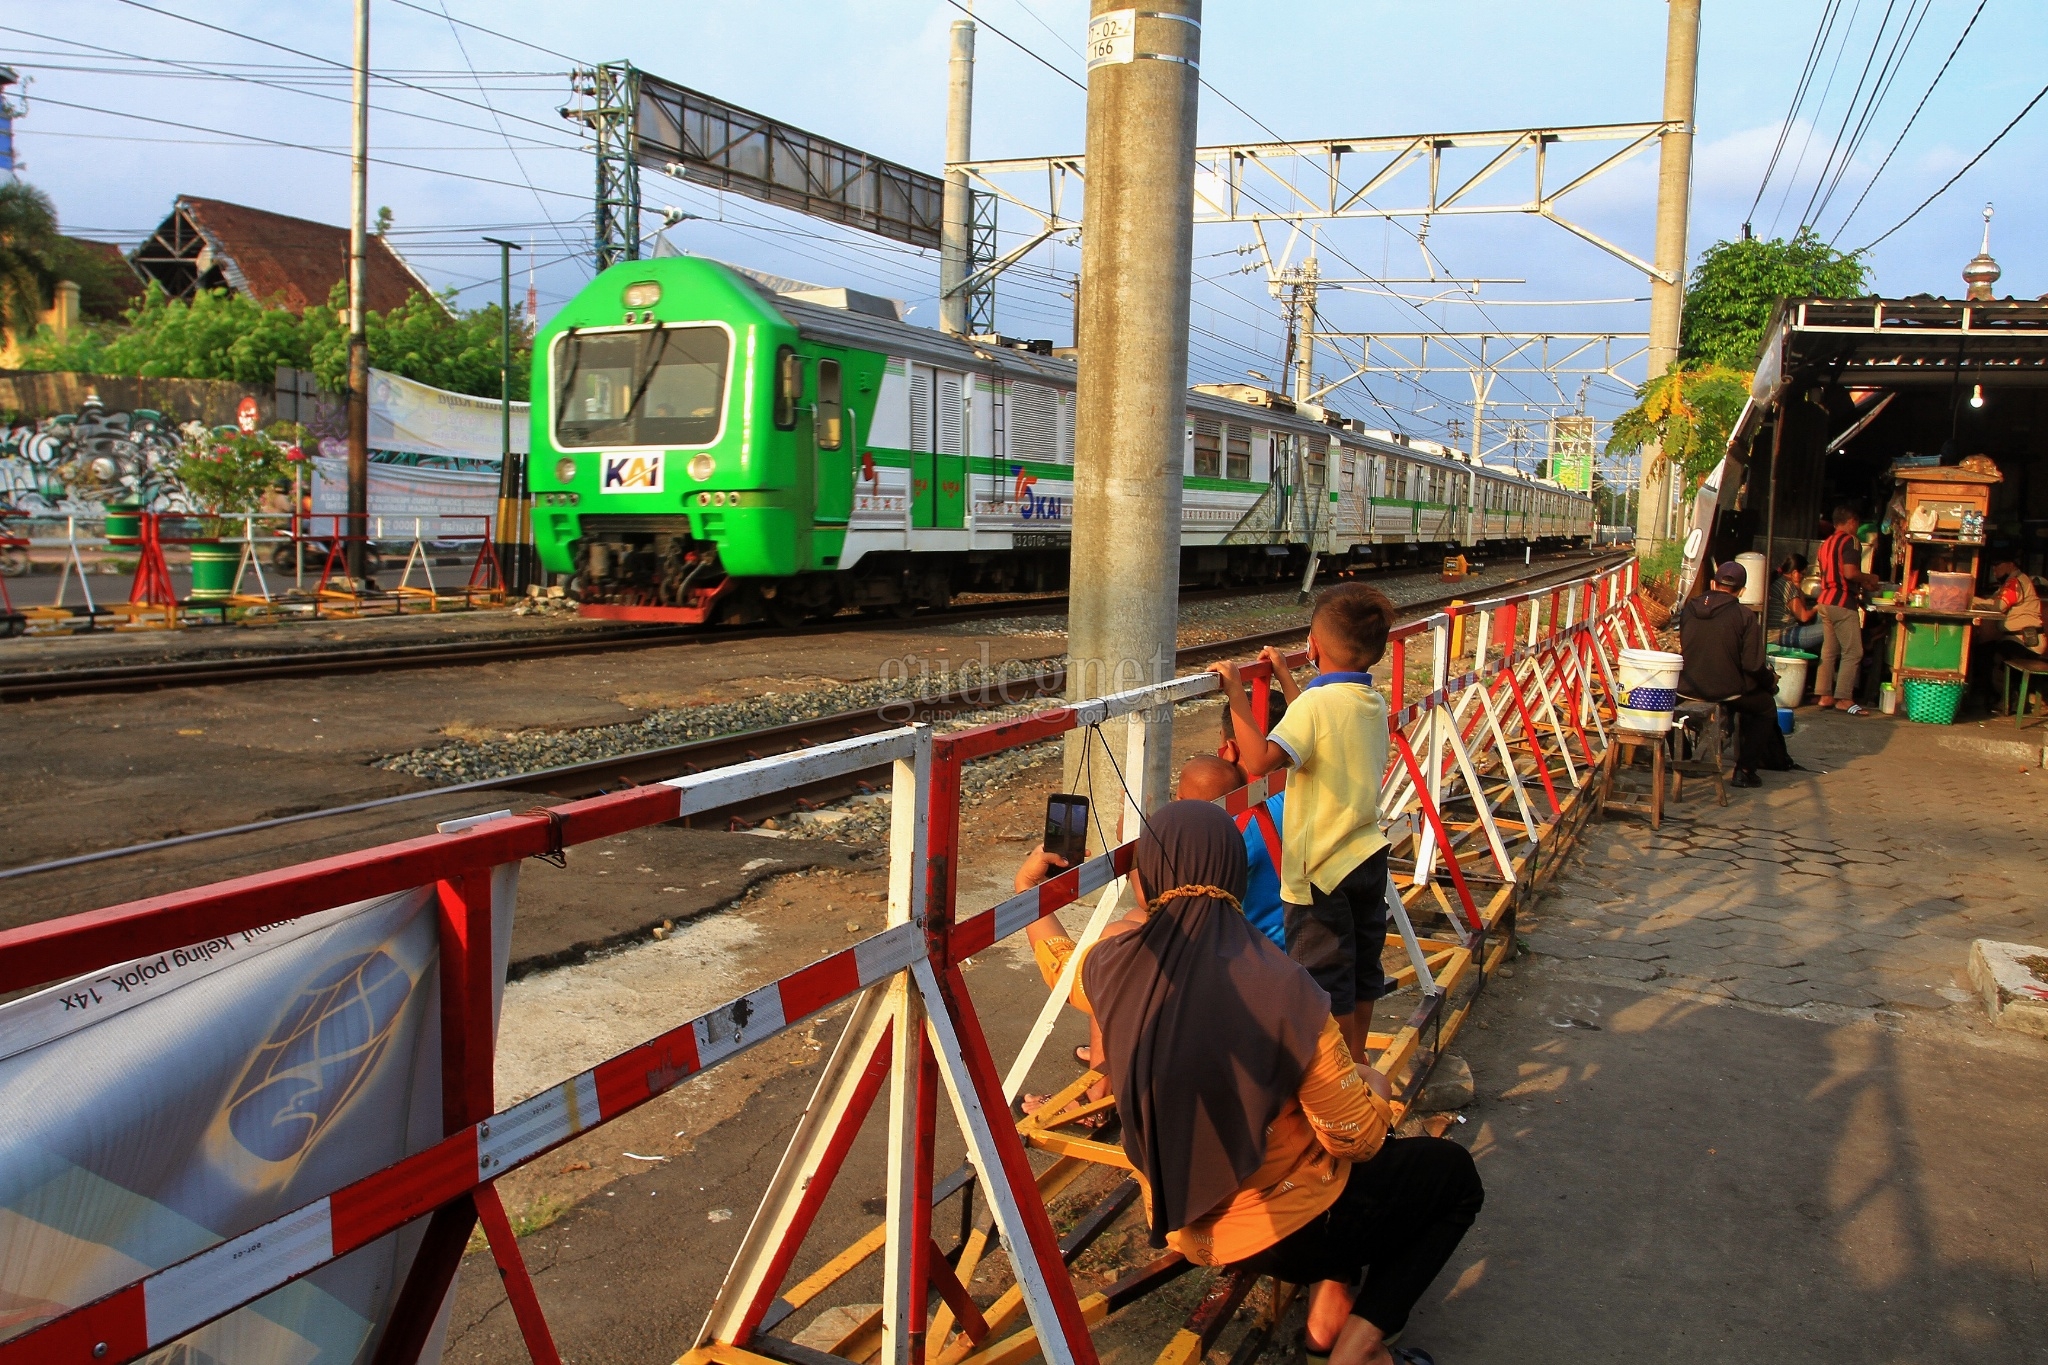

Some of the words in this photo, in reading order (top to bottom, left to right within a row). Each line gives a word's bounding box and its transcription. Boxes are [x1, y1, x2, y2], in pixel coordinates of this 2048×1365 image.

[1094, 40, 1113, 58] 166
[604, 457, 659, 488] KAI
[1036, 496, 1061, 520] KAI
[173, 936, 235, 968] keling
[1192, 1233, 1215, 1247] PARIS
